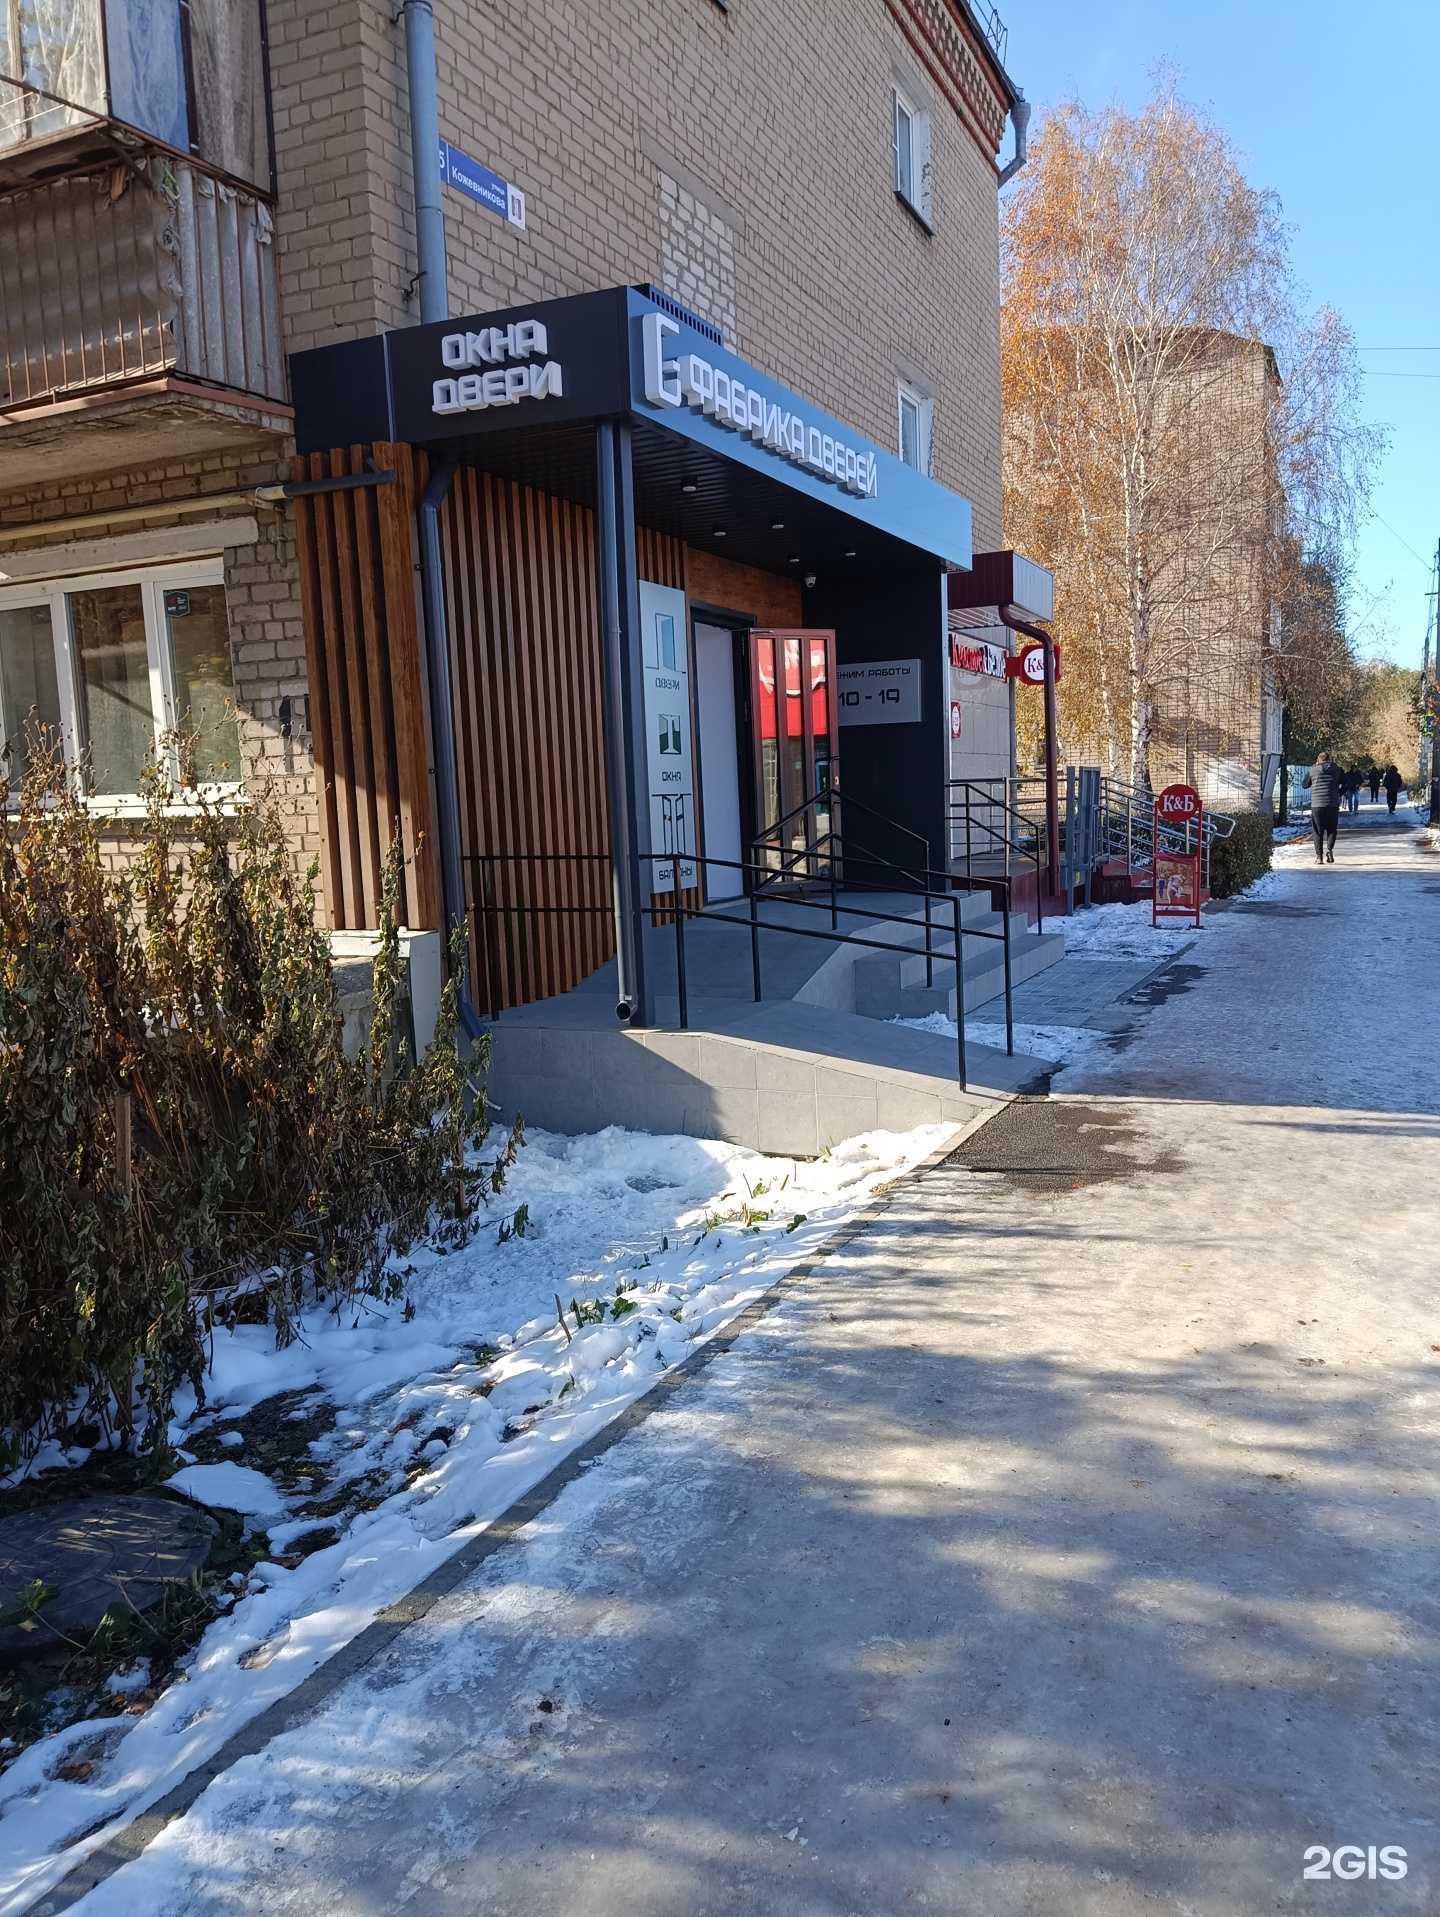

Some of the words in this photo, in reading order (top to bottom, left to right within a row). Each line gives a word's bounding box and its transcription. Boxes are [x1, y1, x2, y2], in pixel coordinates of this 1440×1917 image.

[441, 319, 548, 370] ОКНА
[432, 361, 563, 415] ДВЕРИ
[683, 353, 806, 460] ФАБРИКА
[804, 426, 879, 499] ДВЕРЕЙ
[837, 670, 865, 680] ЕЖИМ
[868, 666, 911, 678] РАБОТЫ
[838, 691, 860, 706] 10
[878, 688, 900, 705] 19
[661, 771, 682, 782] ОКНА
[1162, 794, 1195, 812] К&Б
